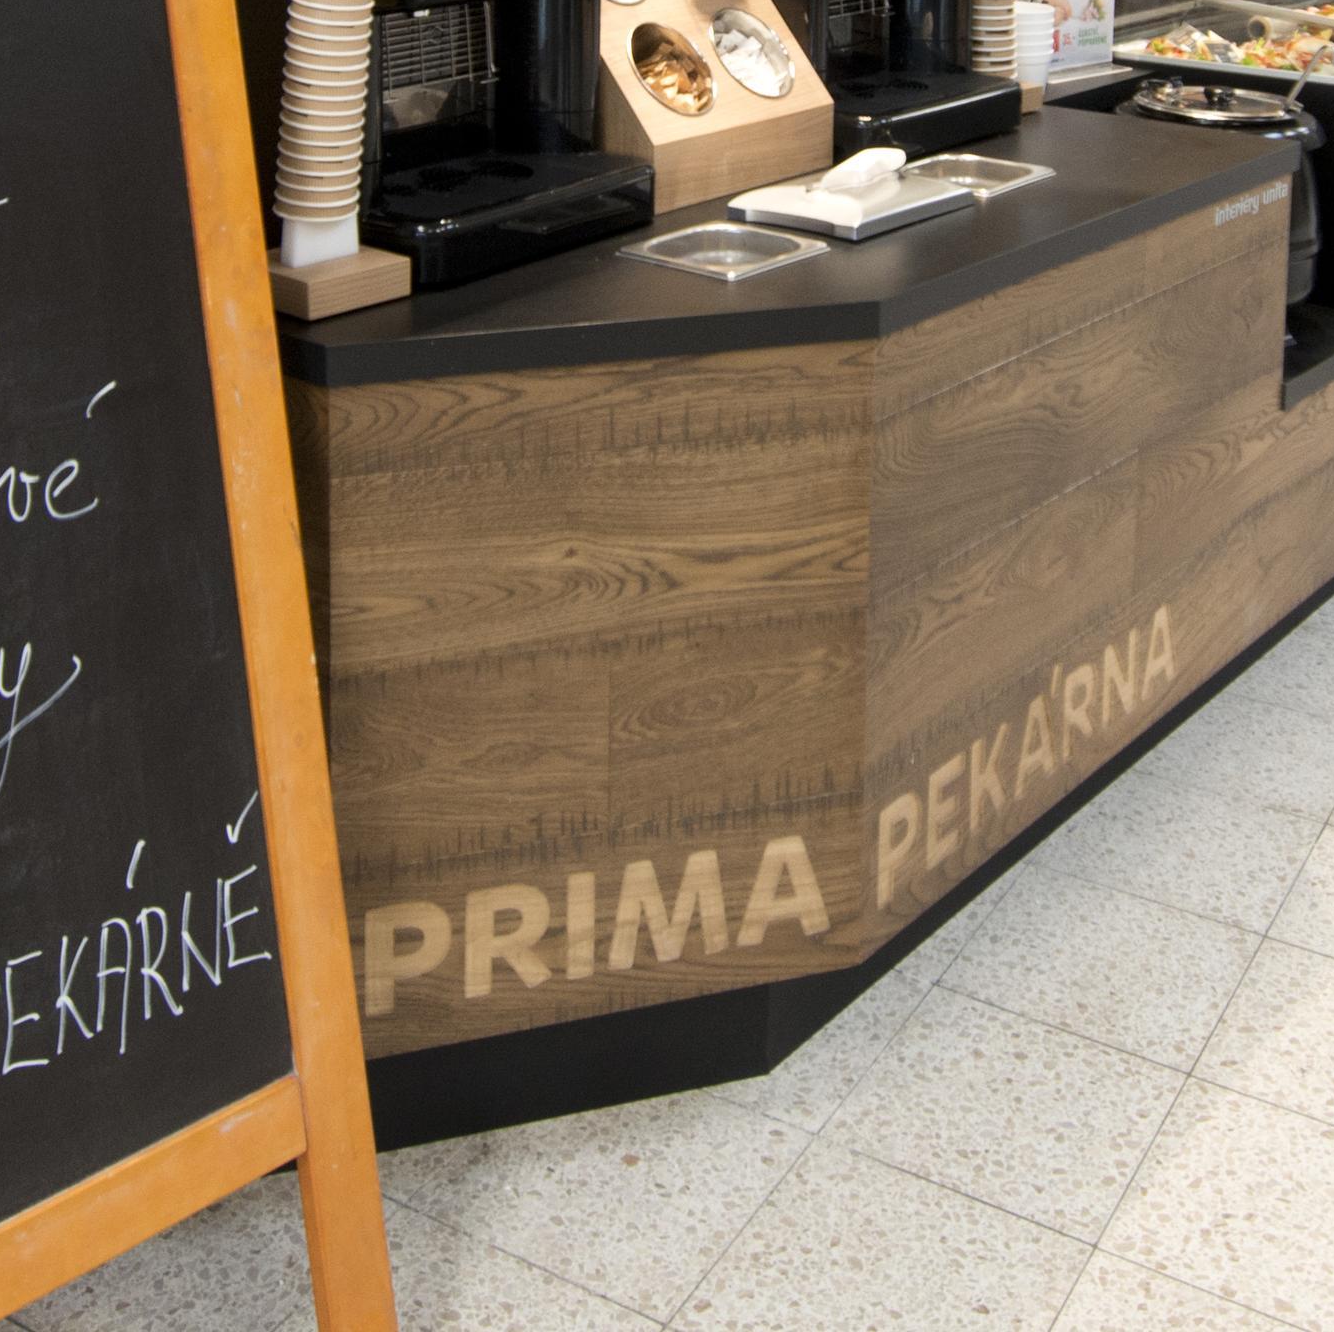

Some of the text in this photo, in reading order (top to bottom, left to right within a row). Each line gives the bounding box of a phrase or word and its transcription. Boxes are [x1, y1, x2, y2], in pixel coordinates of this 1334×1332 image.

[1263, 180, 1288, 204] unita
[364, 603, 1176, 1018] PRIMA PEKÁRNA
